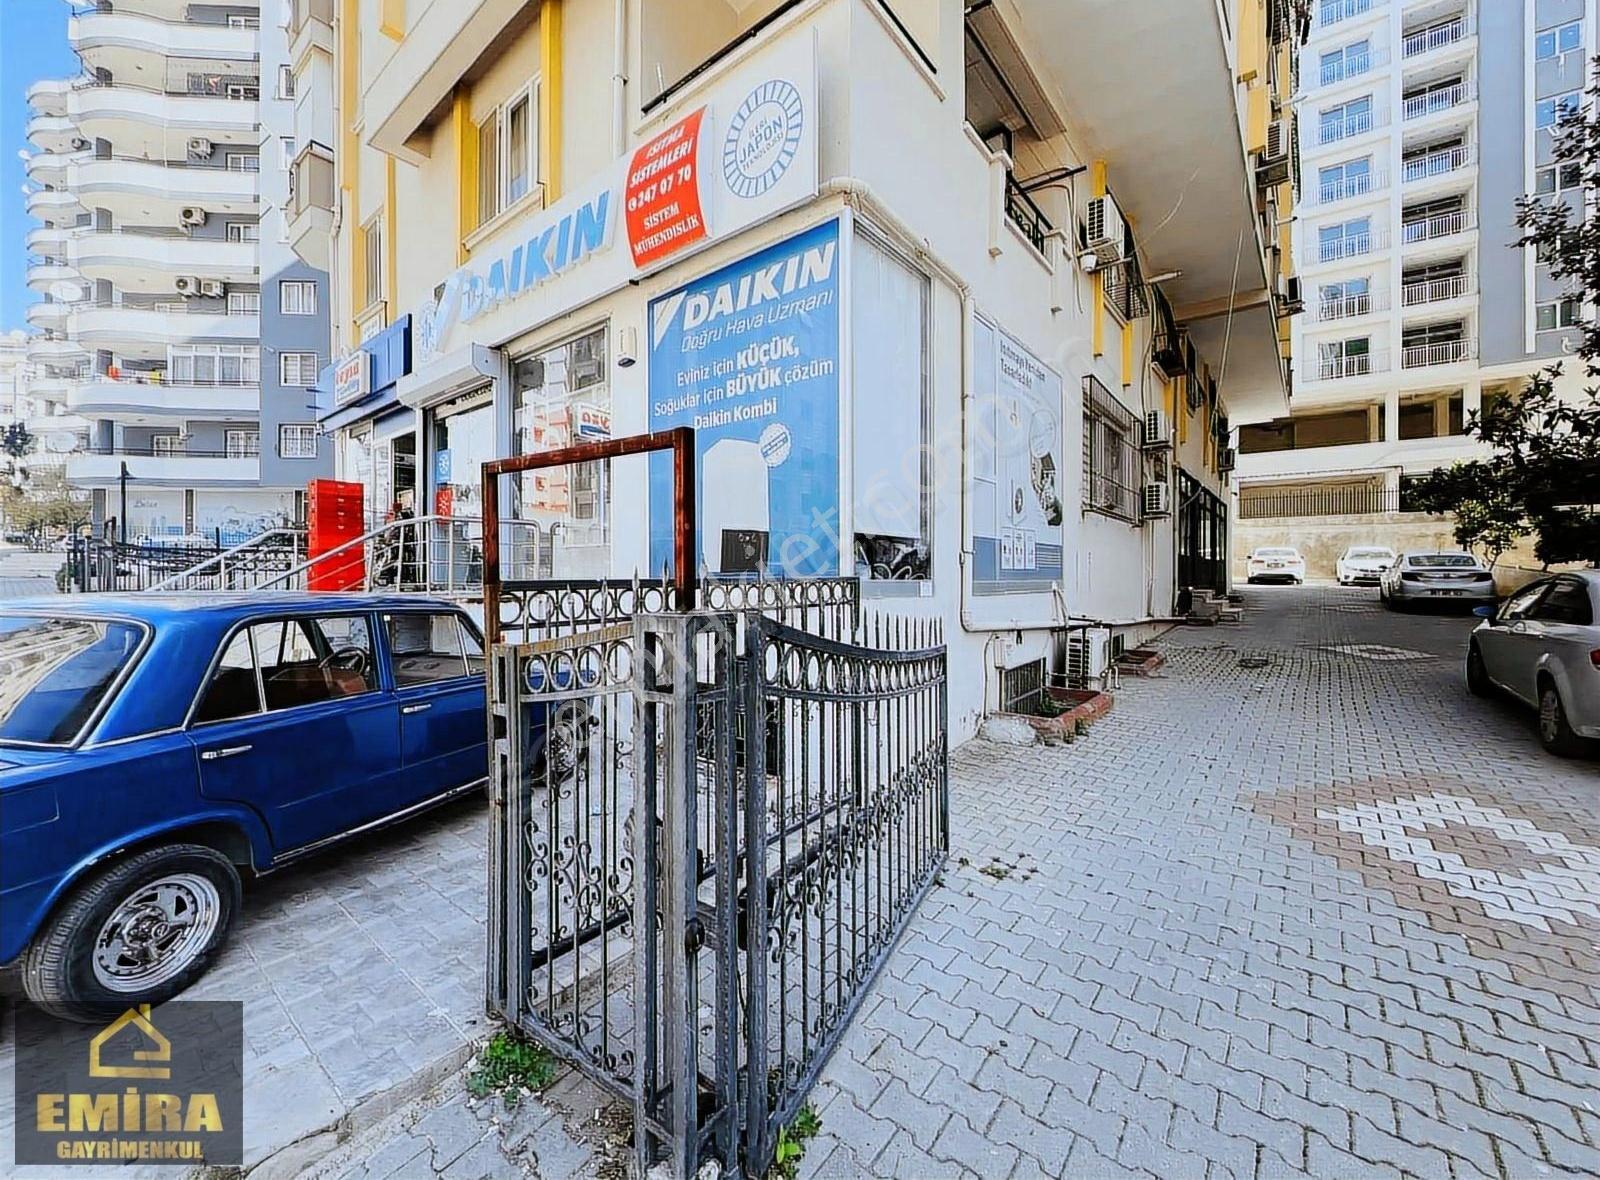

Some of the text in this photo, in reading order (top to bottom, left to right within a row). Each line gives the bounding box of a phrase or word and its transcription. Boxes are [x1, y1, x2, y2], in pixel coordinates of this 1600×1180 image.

[740, 115, 783, 164] JAPON
[638, 164, 692, 208] 247 07 70
[643, 201, 680, 230] SİSTEM
[458, 189, 610, 325] DAIKIN
[683, 241, 836, 331] DAIKIN
[682, 289, 833, 353] Doğru Hava Uzmanı
[655, 359, 834, 417] Soğuklar için BÜYÜK çözüm
[677, 335, 800, 388] Eviniz için KÜÇÜK,
[694, 397, 778, 430] Daikin Kombi
